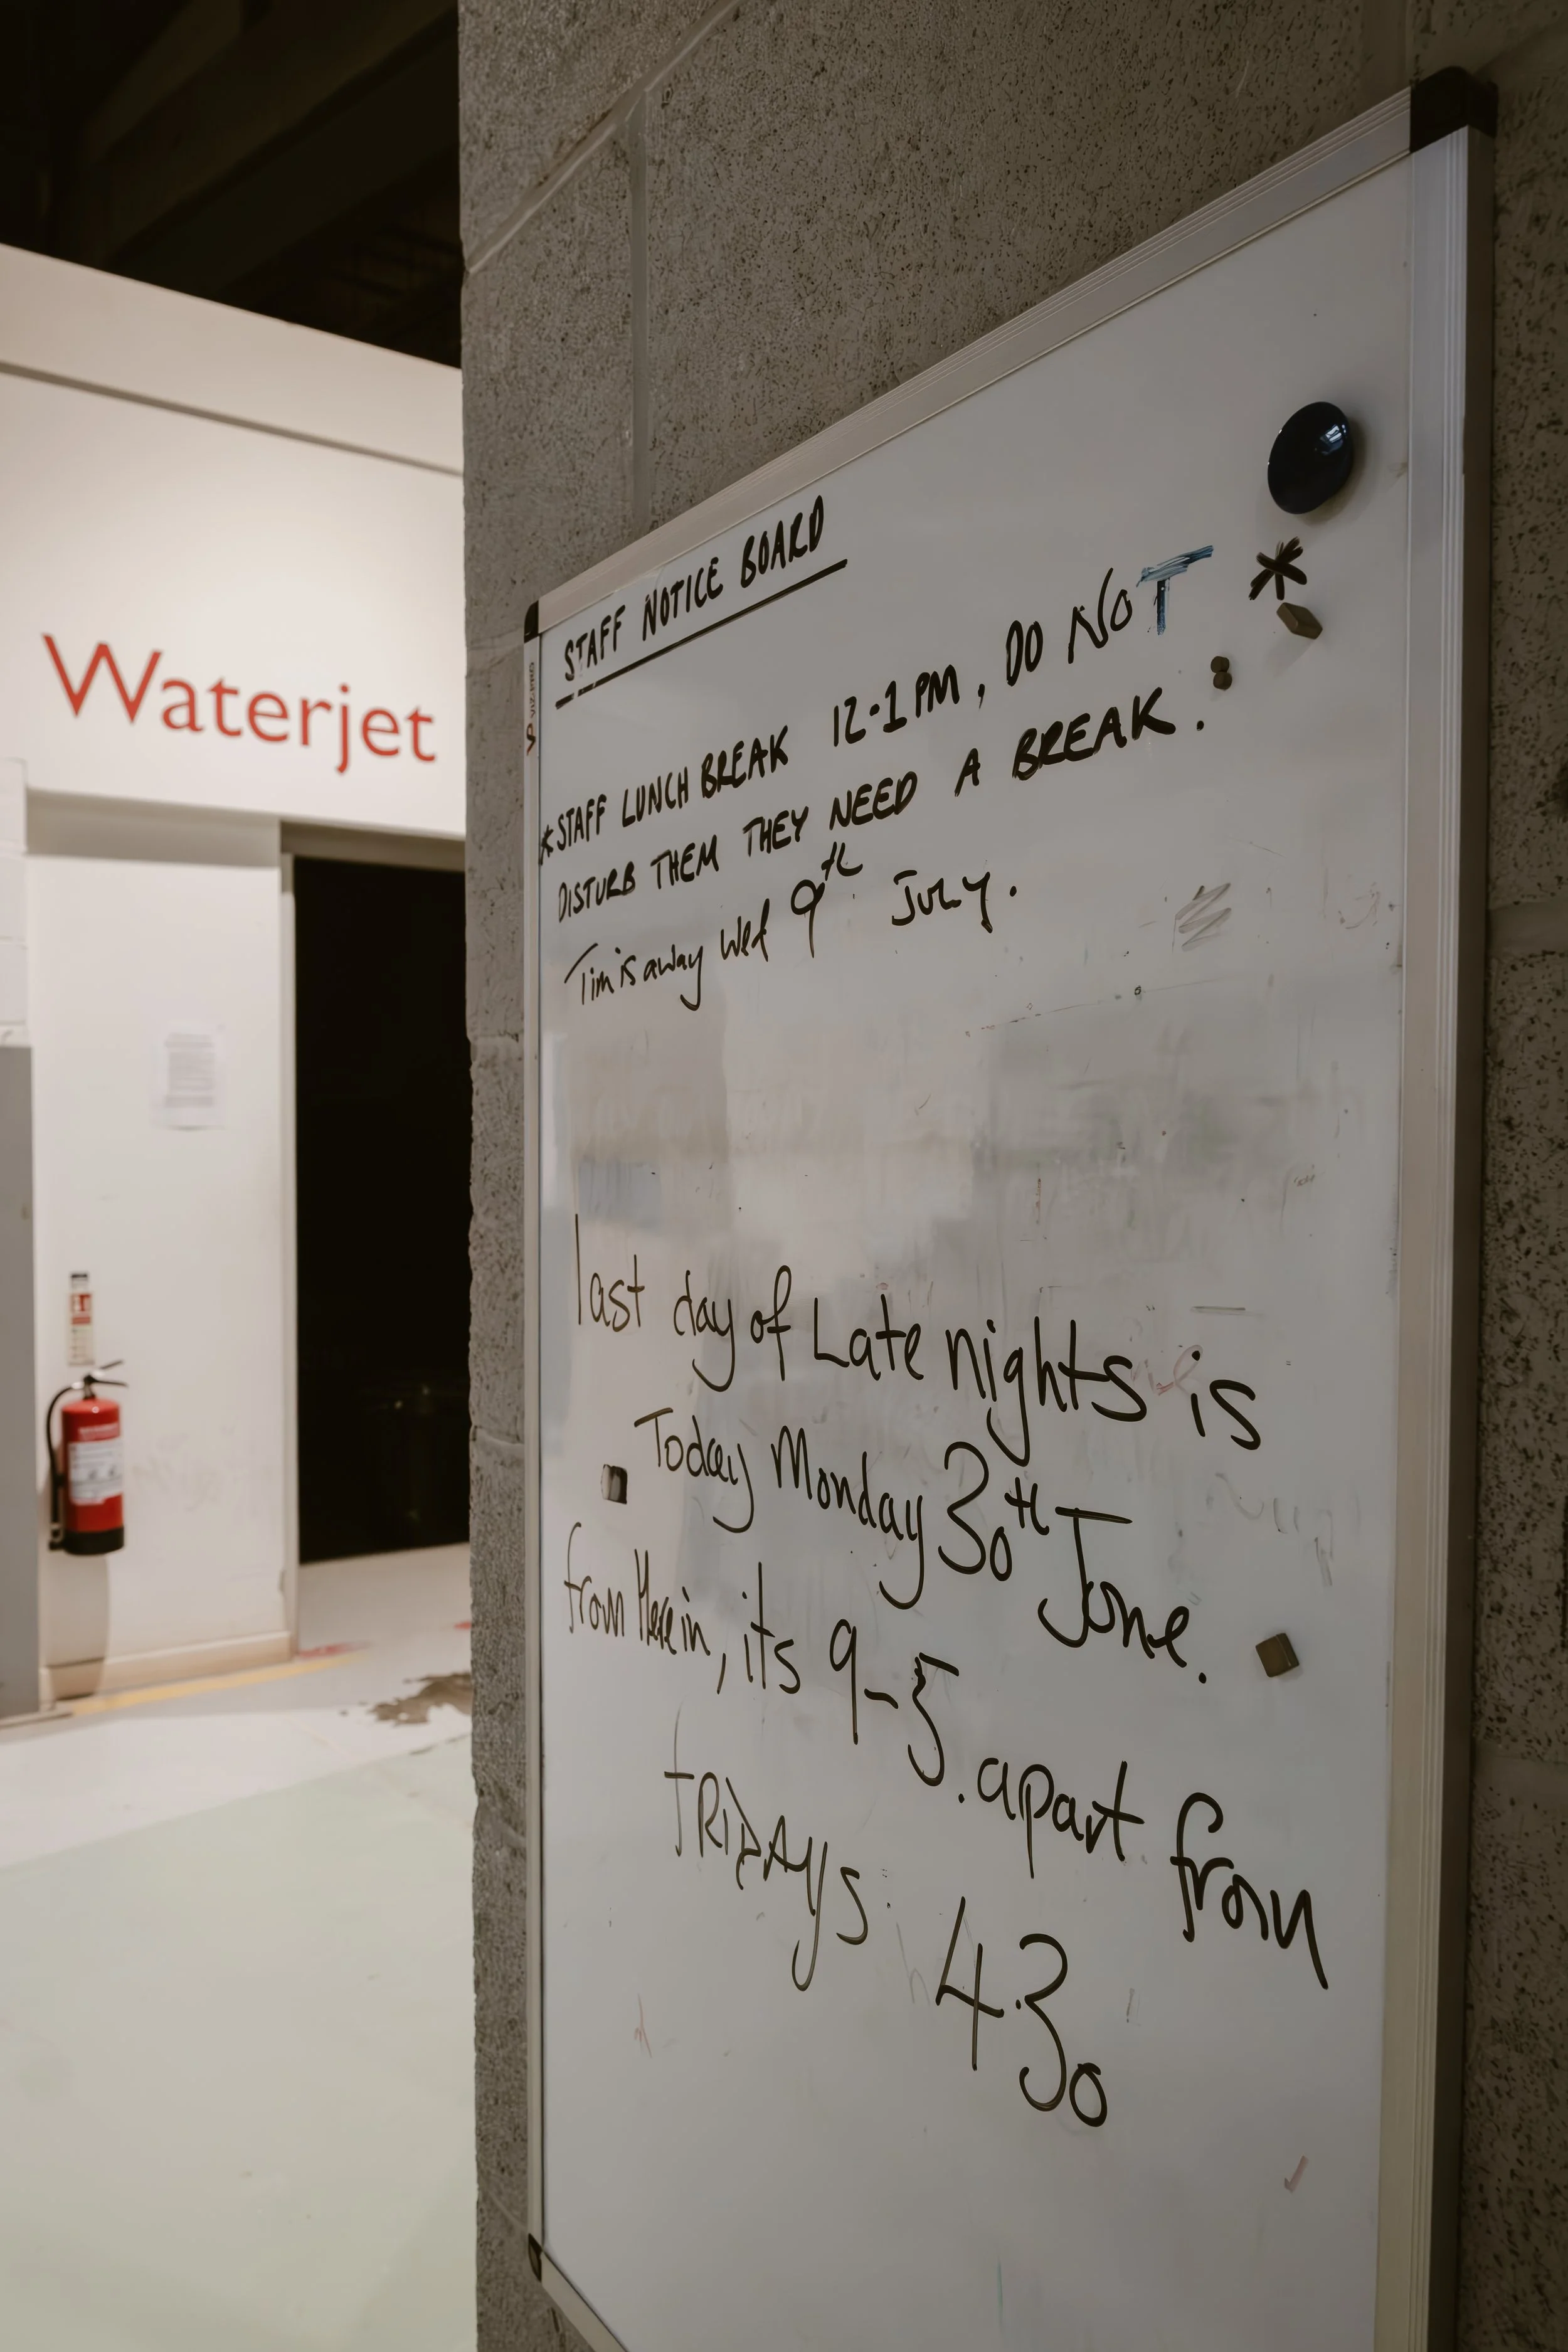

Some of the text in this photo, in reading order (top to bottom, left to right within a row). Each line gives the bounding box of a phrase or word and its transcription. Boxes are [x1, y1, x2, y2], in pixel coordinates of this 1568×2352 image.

[563, 494, 825, 682] STAFF NOTICE BOARD
[41, 633, 437, 775] Waterjet
[556, 792, 608, 853] STAFF
[620, 764, 690, 829] LUNCH
[699, 723, 790, 800] BREAK
[1004, 618, 1044, 687] DO
[1065, 543, 1216, 665] NOT
[557, 859, 637, 924] DISTURB
[649, 833, 721, 891] THEM
[741, 804, 810, 859] THEY
[828, 770, 919, 832] NEED
[952, 746, 982, 798] A
[563, 941, 616, 1007] Tim
[614, 946, 637, 989] is
[641, 941, 705, 1013] away
[719, 896, 771, 963] Wed
[672, 1268, 736, 1394] day
[749, 1263, 793, 1382] of
[813, 1291, 925, 1382] Late
[944, 1314, 1148, 1468] nights
[1187, 1347, 1262, 1451] is
[632, 1405, 756, 1535] Today
[769, 1422, 926, 1612] Monday
[1036, 1504, 1208, 1685] June.
[563, 1519, 625, 1634] from
[740, 1560, 802, 1695] its
[975, 1755, 1145, 1880] apart
[1169, 1791, 1330, 1991] from
